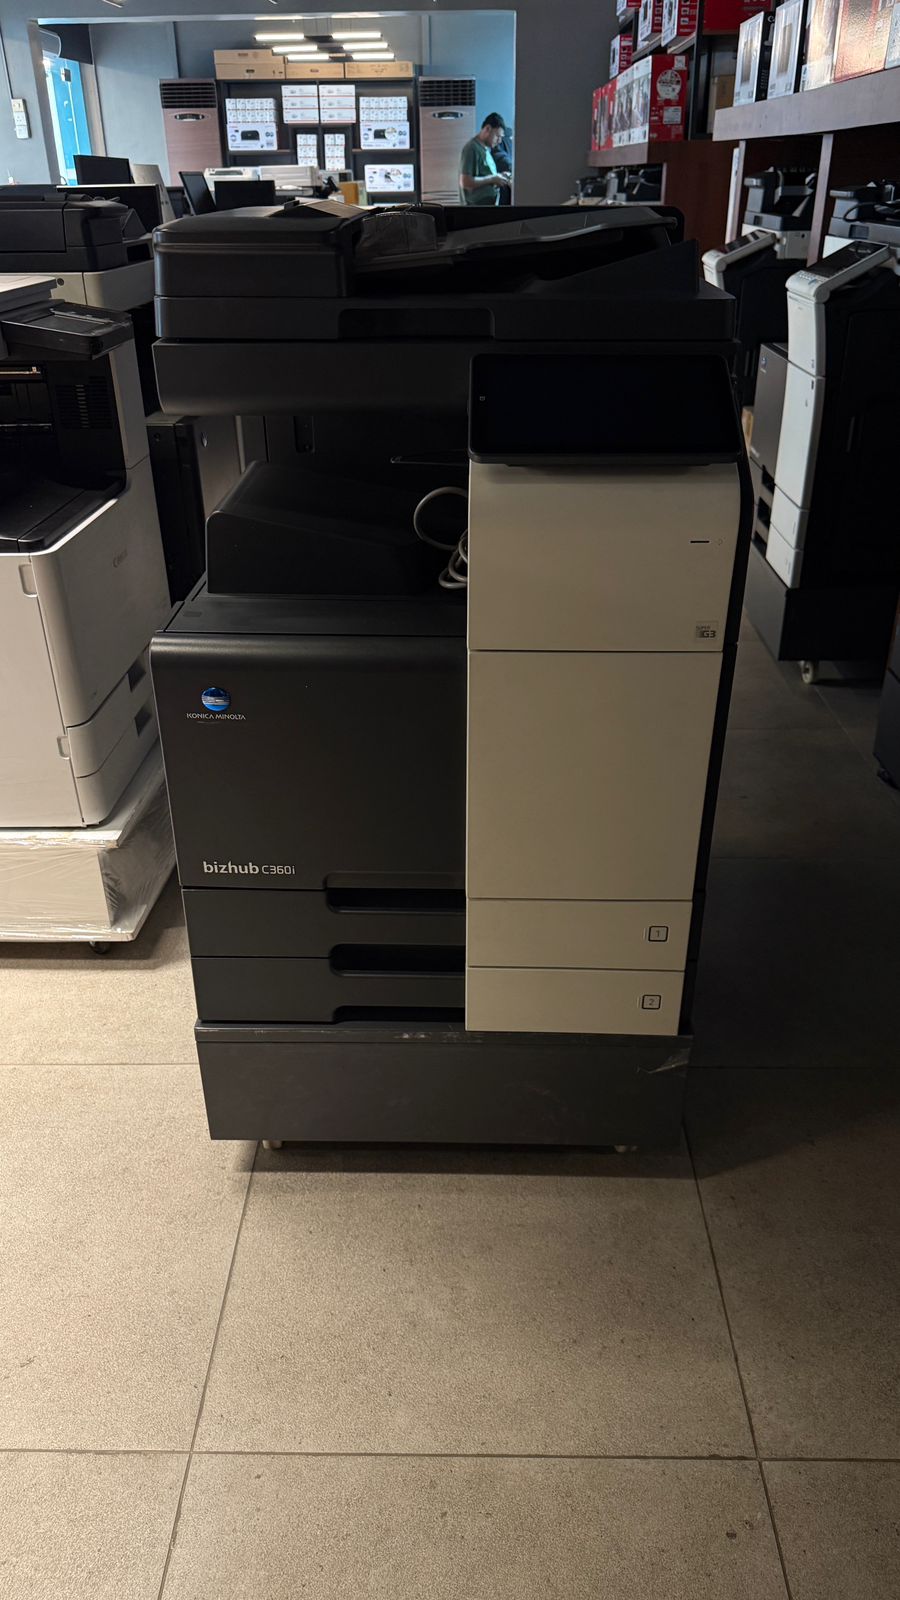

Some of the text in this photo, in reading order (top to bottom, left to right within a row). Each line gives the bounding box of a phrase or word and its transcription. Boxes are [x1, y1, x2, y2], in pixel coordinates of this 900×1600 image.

[215, 713, 246, 721] MINOLTA
[203, 861, 295, 875] bizhub C360i
